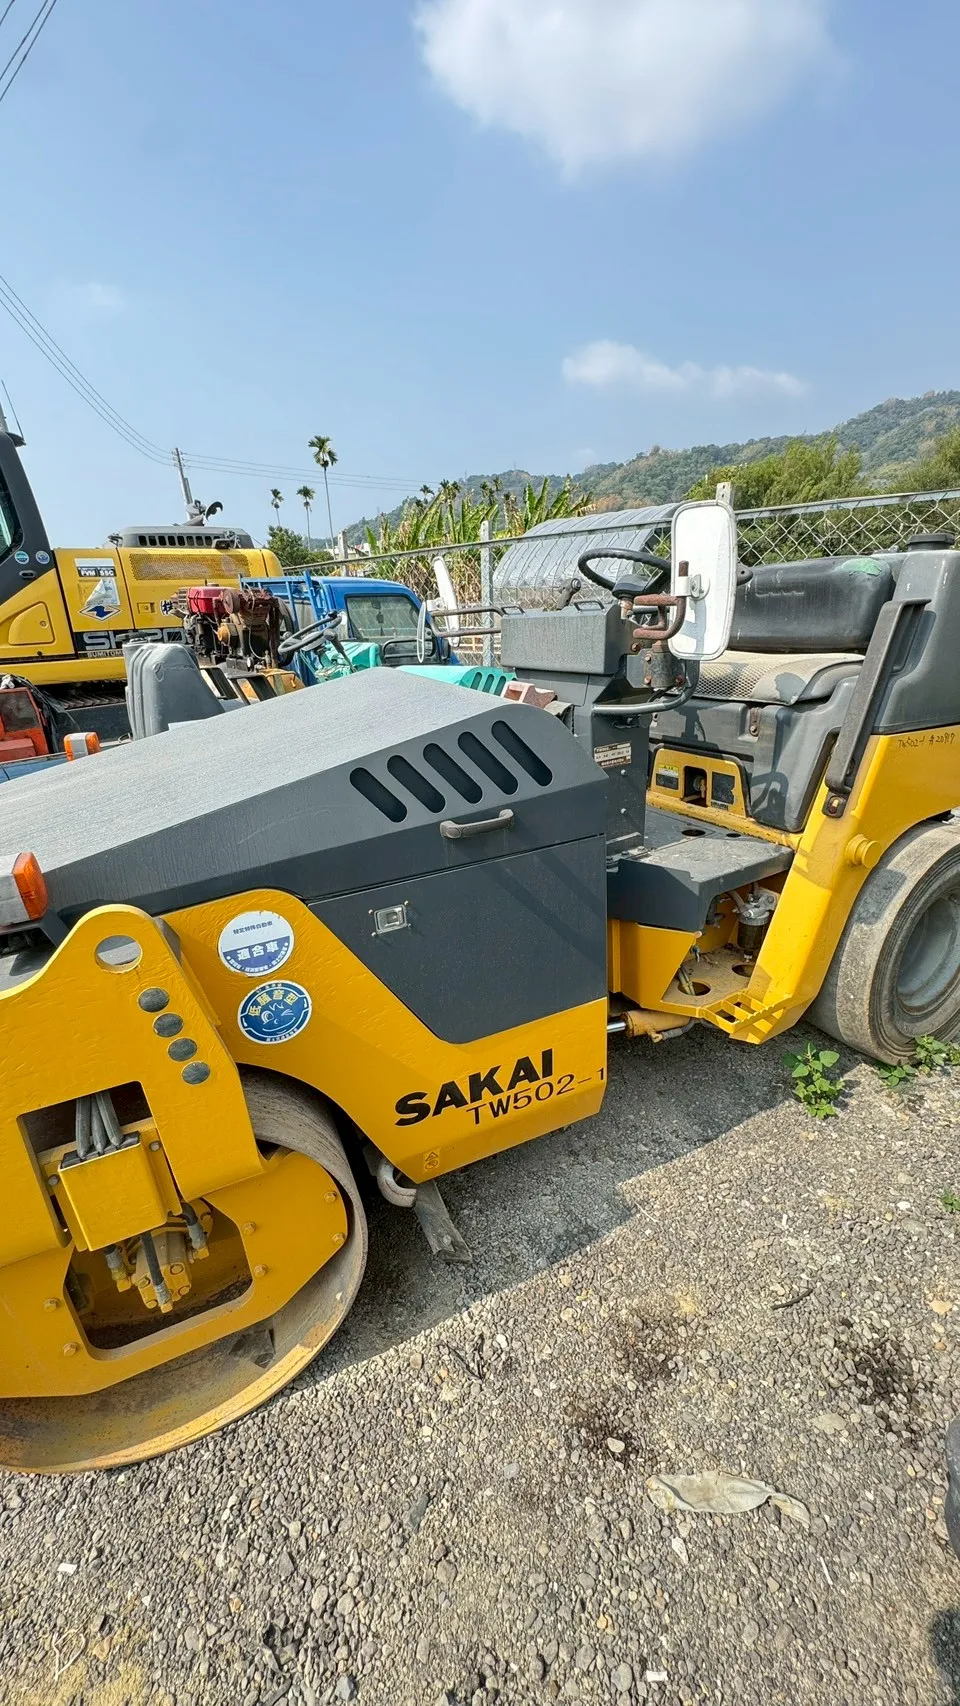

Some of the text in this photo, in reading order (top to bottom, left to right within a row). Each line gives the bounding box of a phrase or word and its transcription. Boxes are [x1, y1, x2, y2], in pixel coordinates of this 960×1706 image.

[87, 650, 124, 658] SUMITOM
[394, 1048, 553, 1127] SAKAI
[466, 1067, 605, 1124] TW502-1
